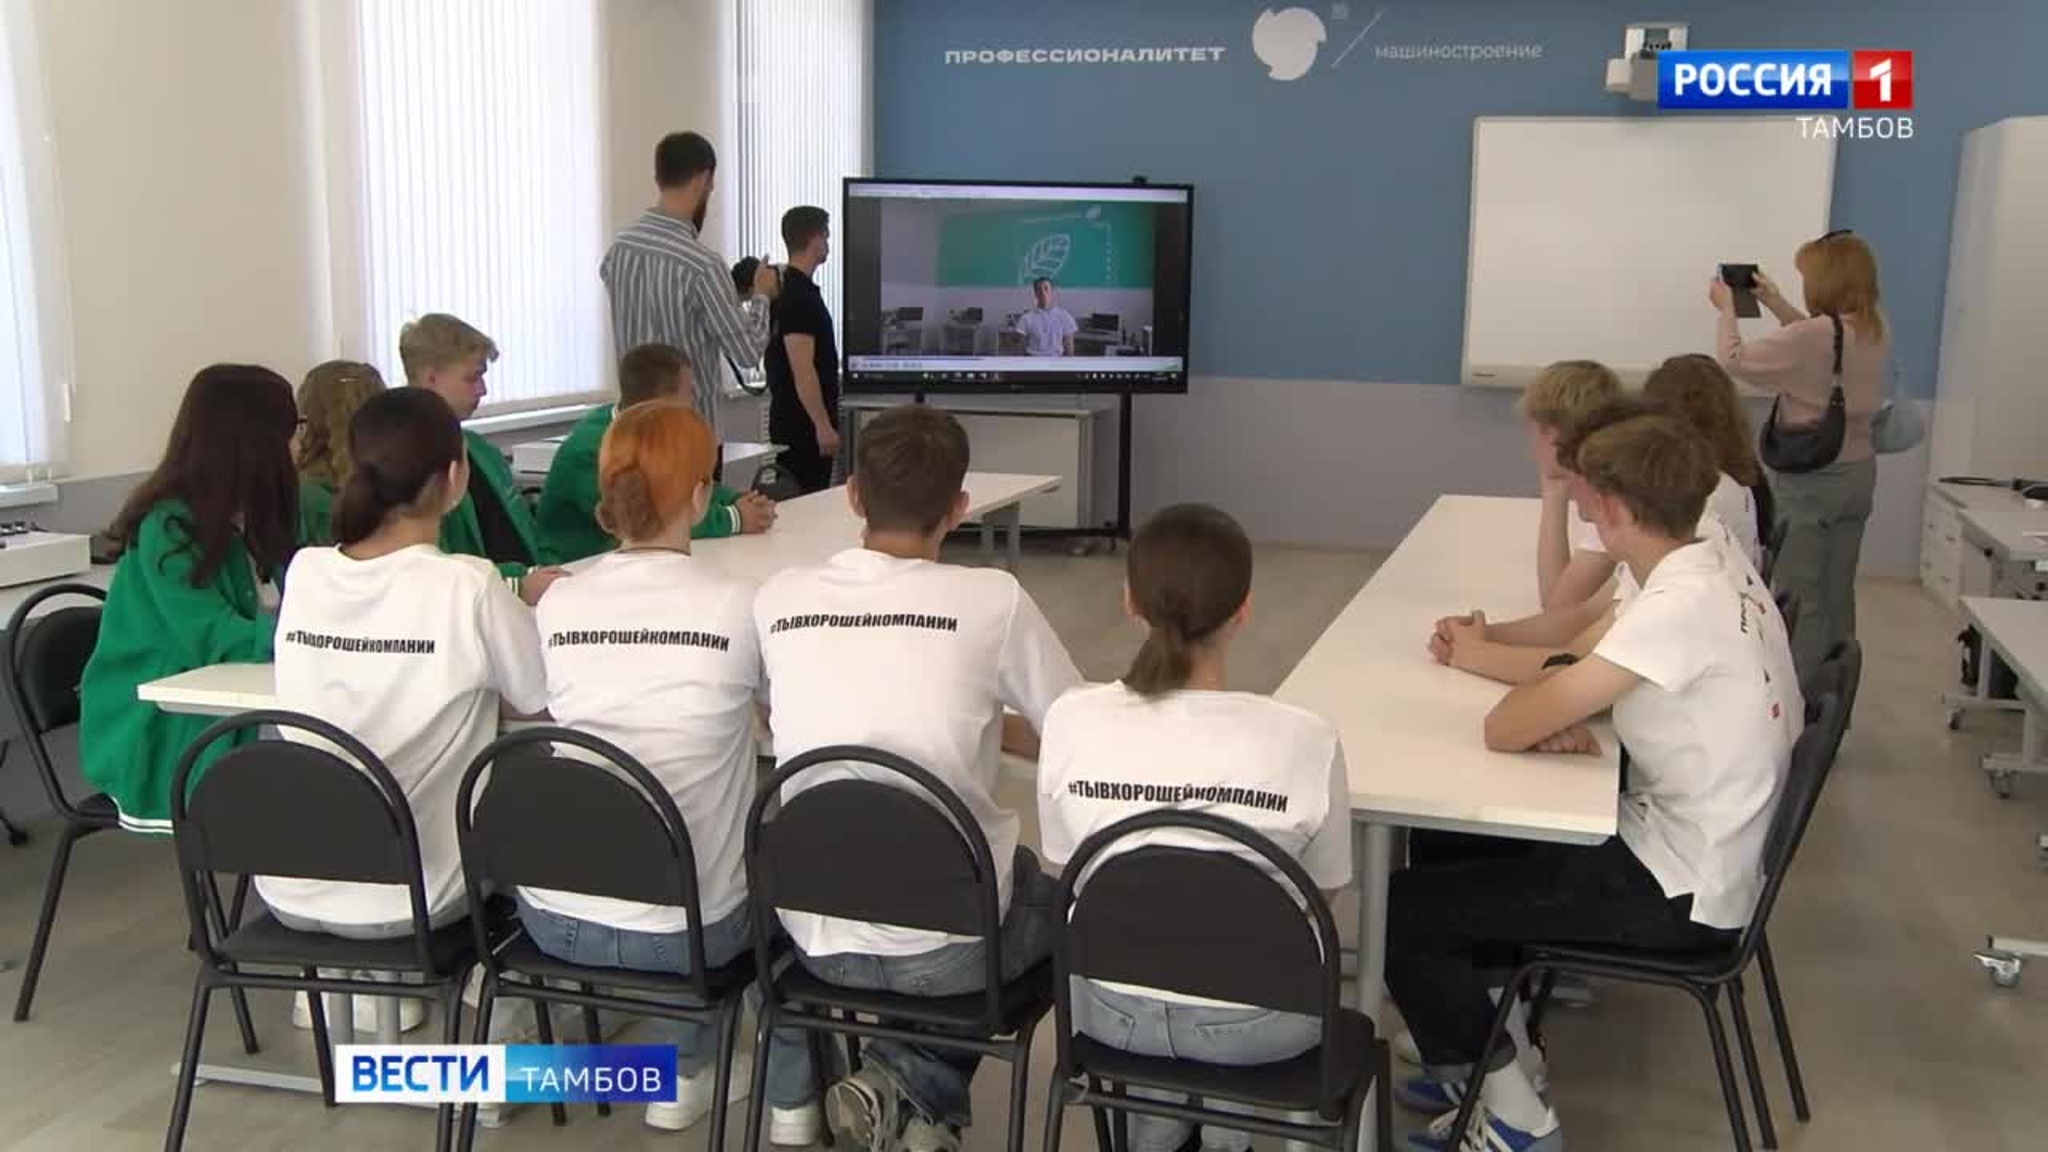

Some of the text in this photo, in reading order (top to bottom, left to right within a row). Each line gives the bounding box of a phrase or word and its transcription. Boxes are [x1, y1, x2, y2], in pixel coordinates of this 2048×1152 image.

[944, 46, 1228, 65] ПРОФЕССИОНАЛИТЕТ
[1375, 43, 1543, 62] машиностроение
[286, 630, 436, 654] #ТЫОРОШЕЙКОМПАНИИ
[1068, 780, 1289, 813] #ТЫВХОРОШЕЙКОМПАНИИ
